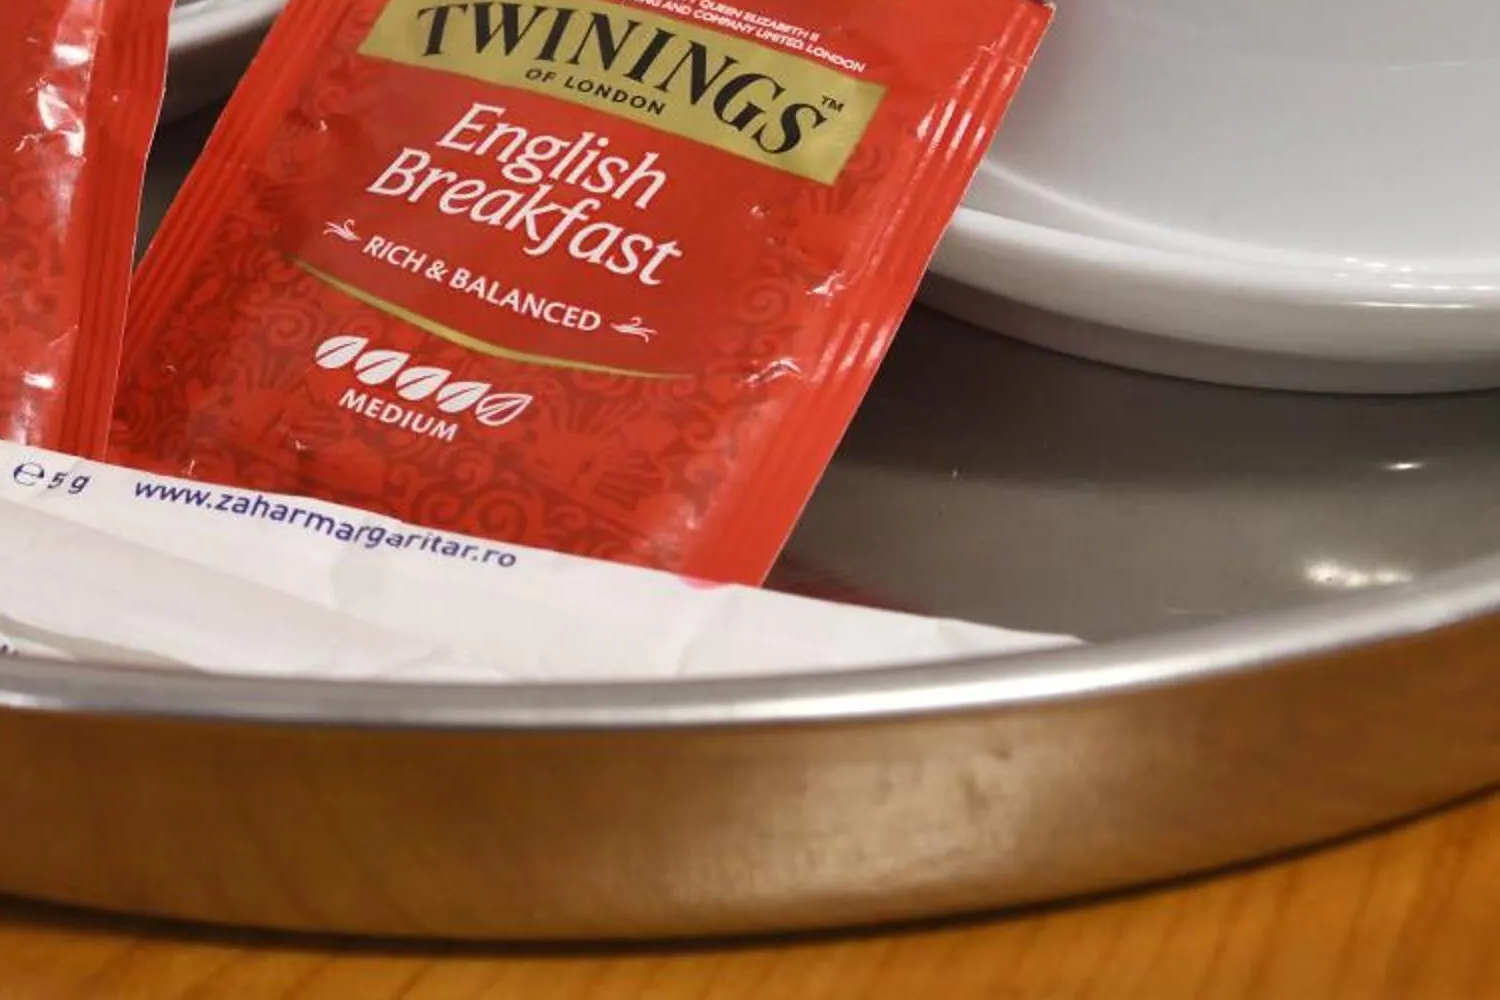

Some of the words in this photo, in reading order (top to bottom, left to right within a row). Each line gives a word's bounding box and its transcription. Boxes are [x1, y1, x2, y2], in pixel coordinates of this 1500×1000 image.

[662, 0, 692, 15] AND
[693, 8, 757, 33] COMPANY
[805, 42, 867, 73] LONDON
[742, 9, 809, 39] ELIZABETH
[415, 0, 831, 156] TWININGS
[526, 67, 558, 84] OF
[563, 74, 667, 117] LONDON
[436, 102, 668, 210] English
[366, 147, 683, 286] Breakfast
[362, 235, 429, 275] RICH
[428, 260, 450, 282] &
[448, 267, 602, 332] BALANCED
[338, 387, 460, 442] MEDIUM
[134, 477, 517, 569] www.zaharmargaritar.ro
